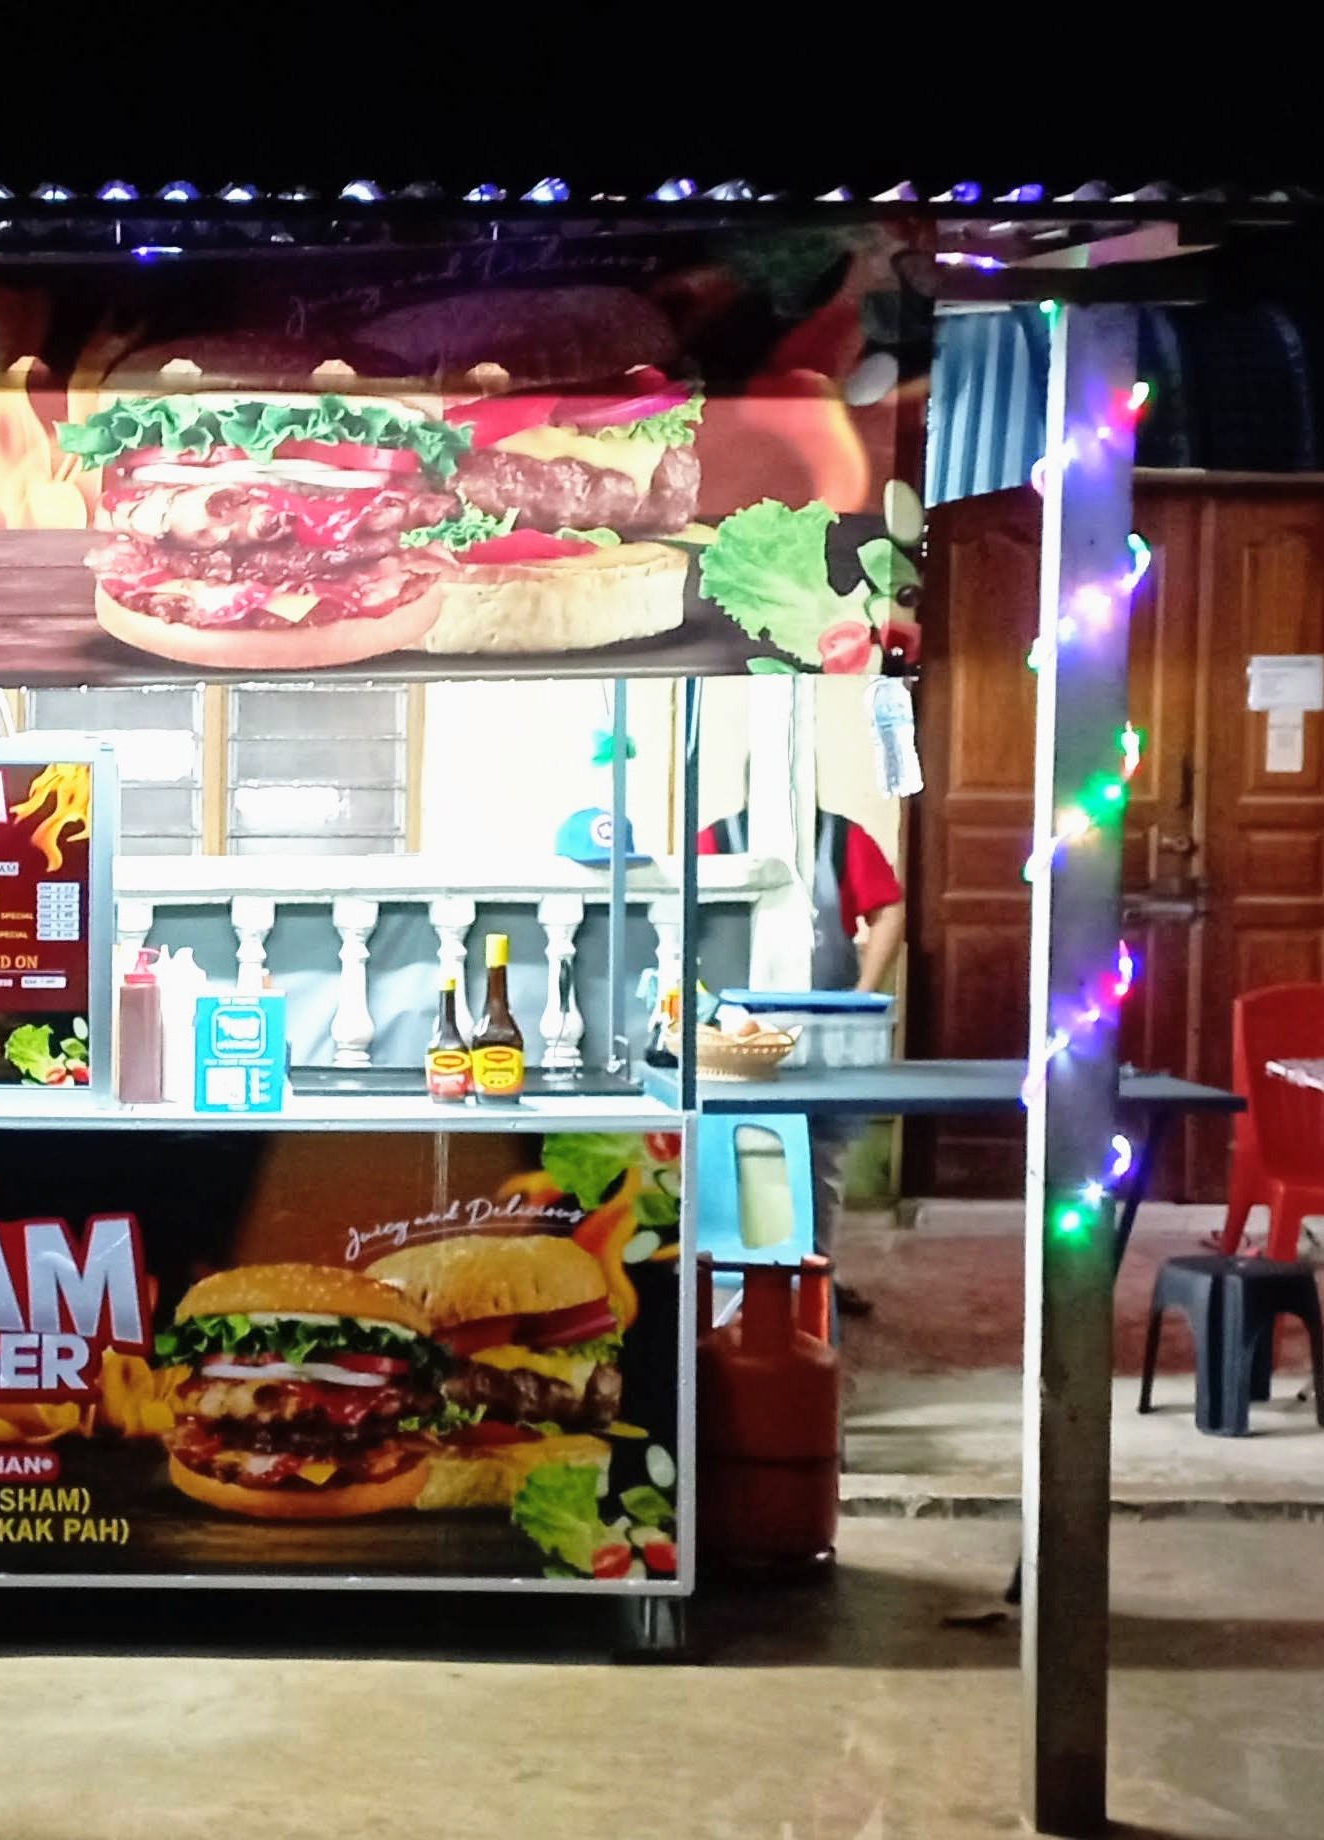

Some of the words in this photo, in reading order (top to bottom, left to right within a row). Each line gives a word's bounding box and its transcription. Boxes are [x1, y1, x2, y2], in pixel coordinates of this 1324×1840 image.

[15, 955, 39, 969] ON
[345, 1219, 409, 1261] Juicy
[465, 1194, 584, 1225] Delicious
[63, 1518, 129, 1544] PAH)
